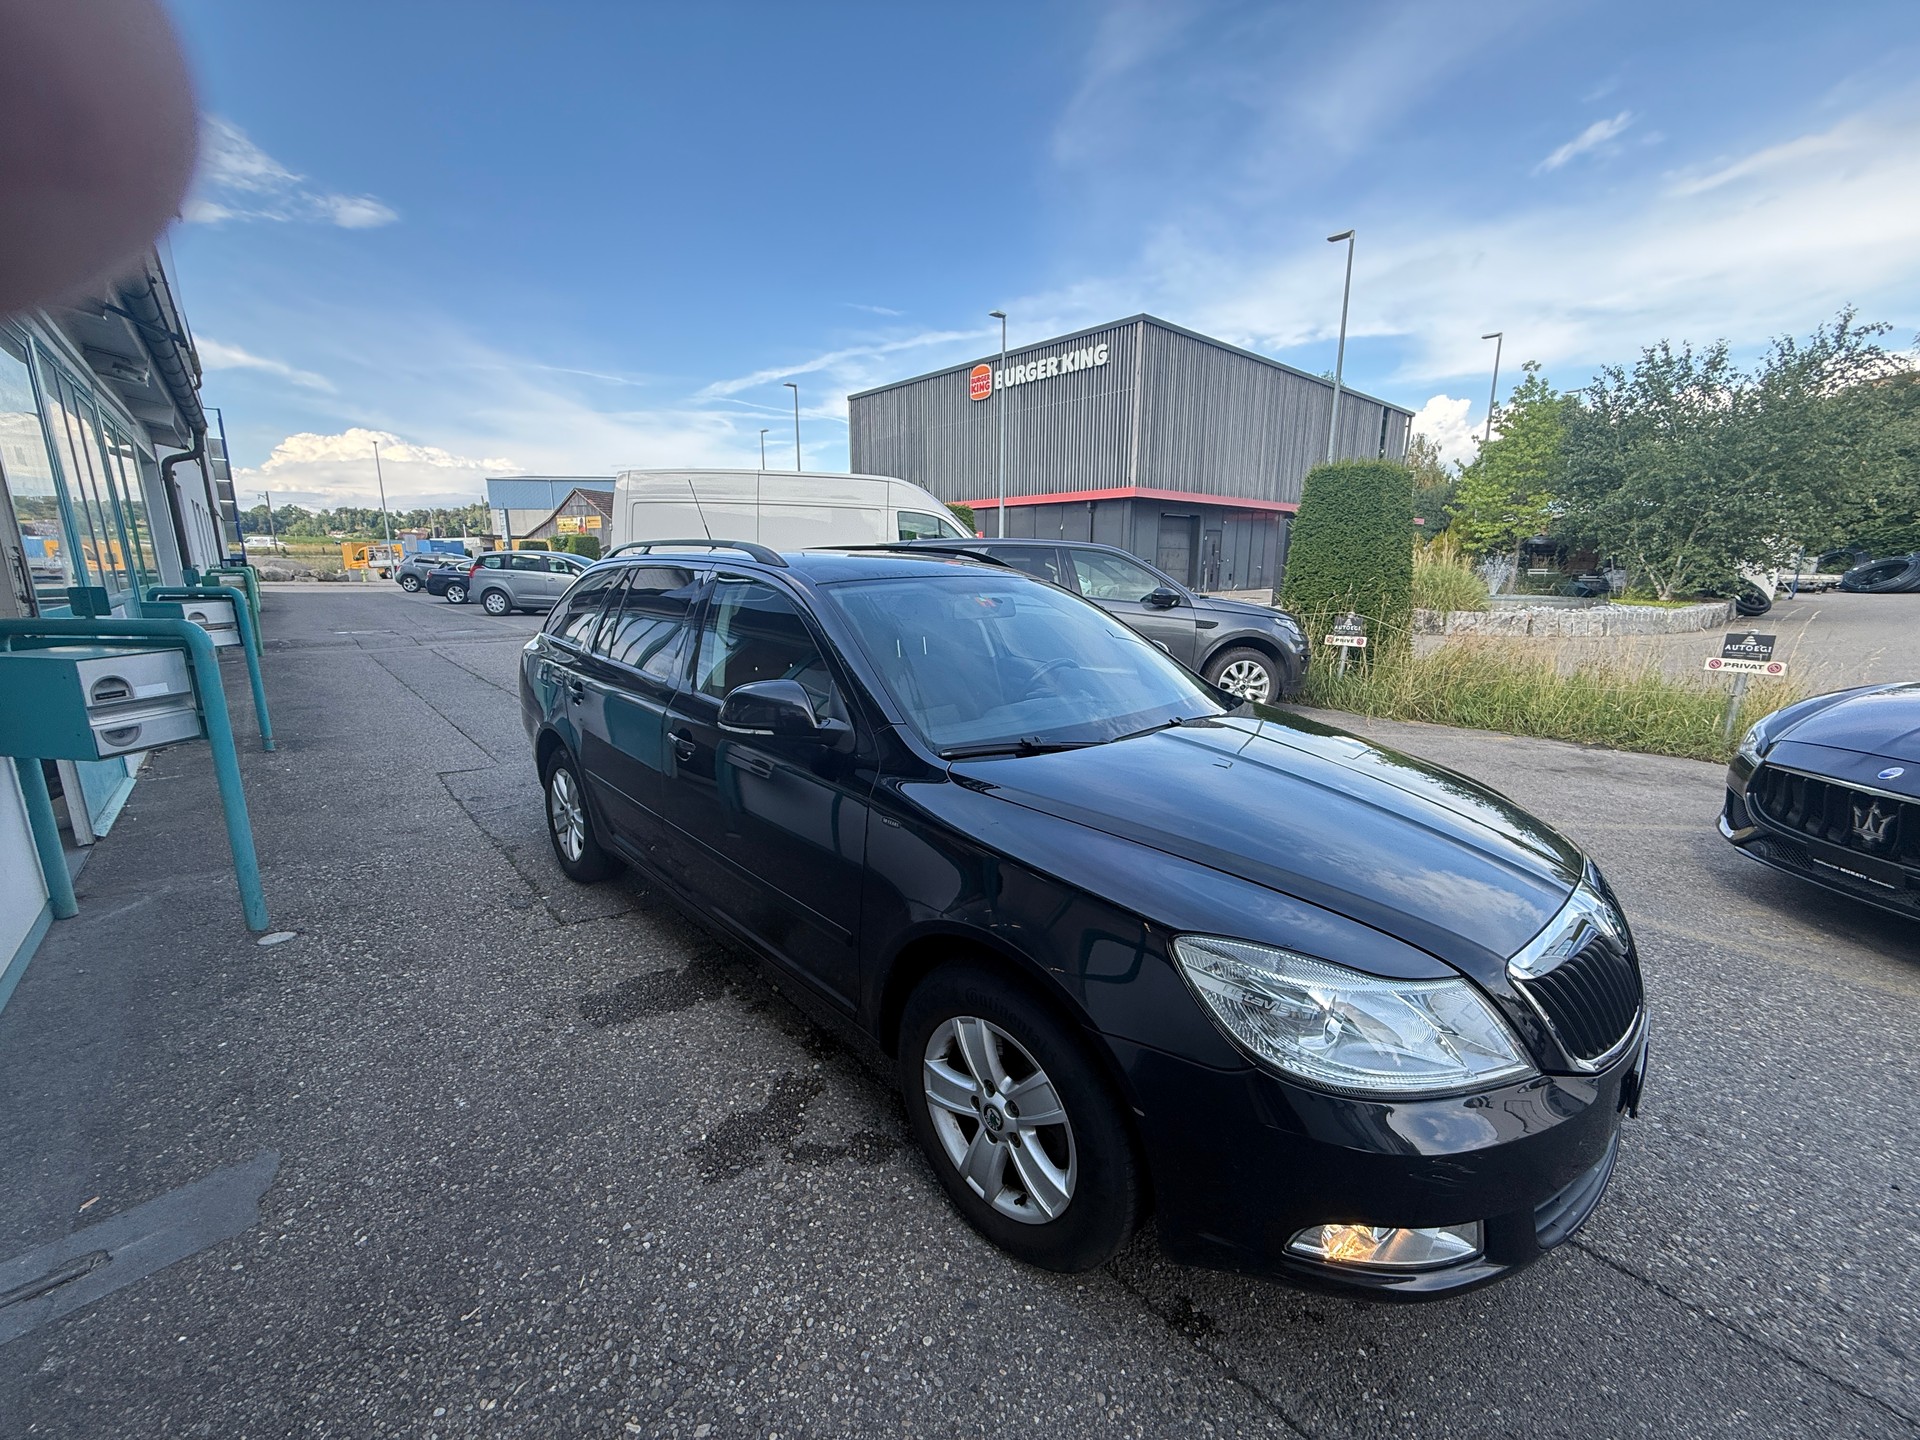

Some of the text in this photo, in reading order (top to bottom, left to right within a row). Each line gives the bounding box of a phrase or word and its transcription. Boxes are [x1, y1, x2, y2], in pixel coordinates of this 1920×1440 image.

[995, 343, 1108, 389] BURGER KING
[971, 374, 990, 384] BURGER
[971, 381, 990, 393] KING
[1723, 662, 1765, 670] PRIVAT
